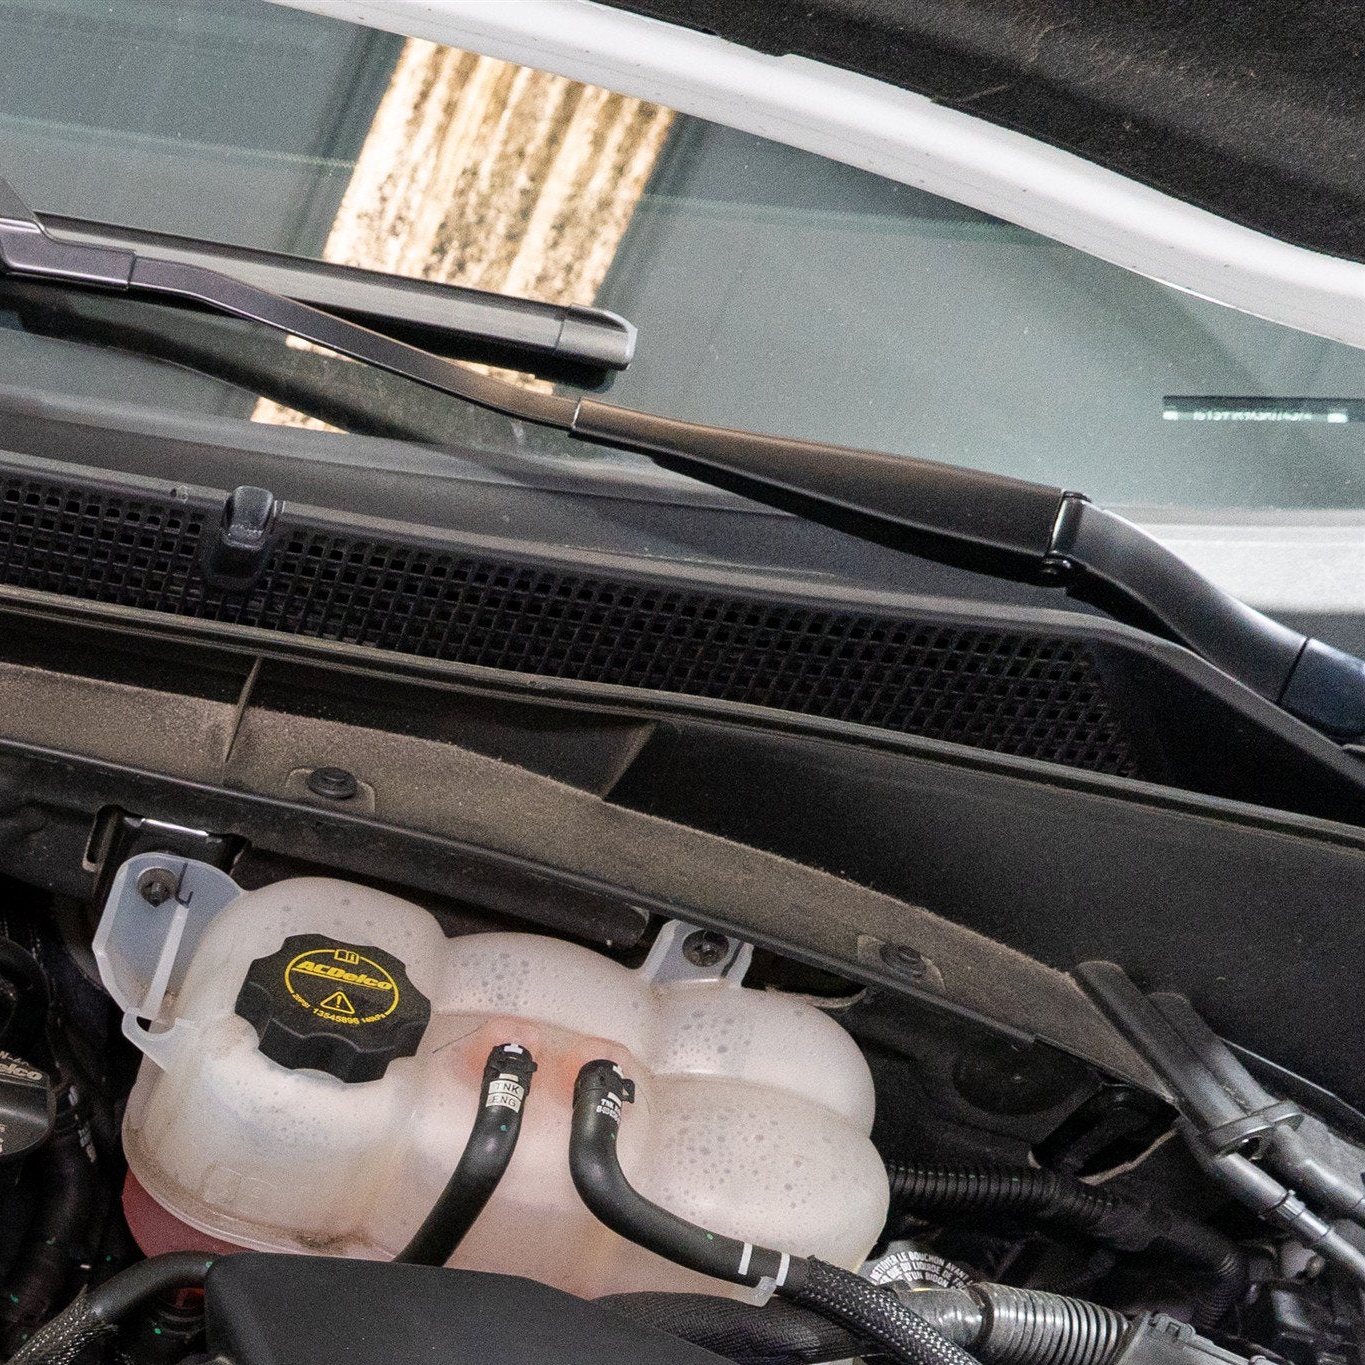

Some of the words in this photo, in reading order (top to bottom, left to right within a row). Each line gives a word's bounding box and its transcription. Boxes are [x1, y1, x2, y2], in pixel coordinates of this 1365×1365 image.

[295, 960, 393, 991] ACDelco
[493, 1083, 520, 1094] TNK
[492, 1096, 516, 1107] ENG
